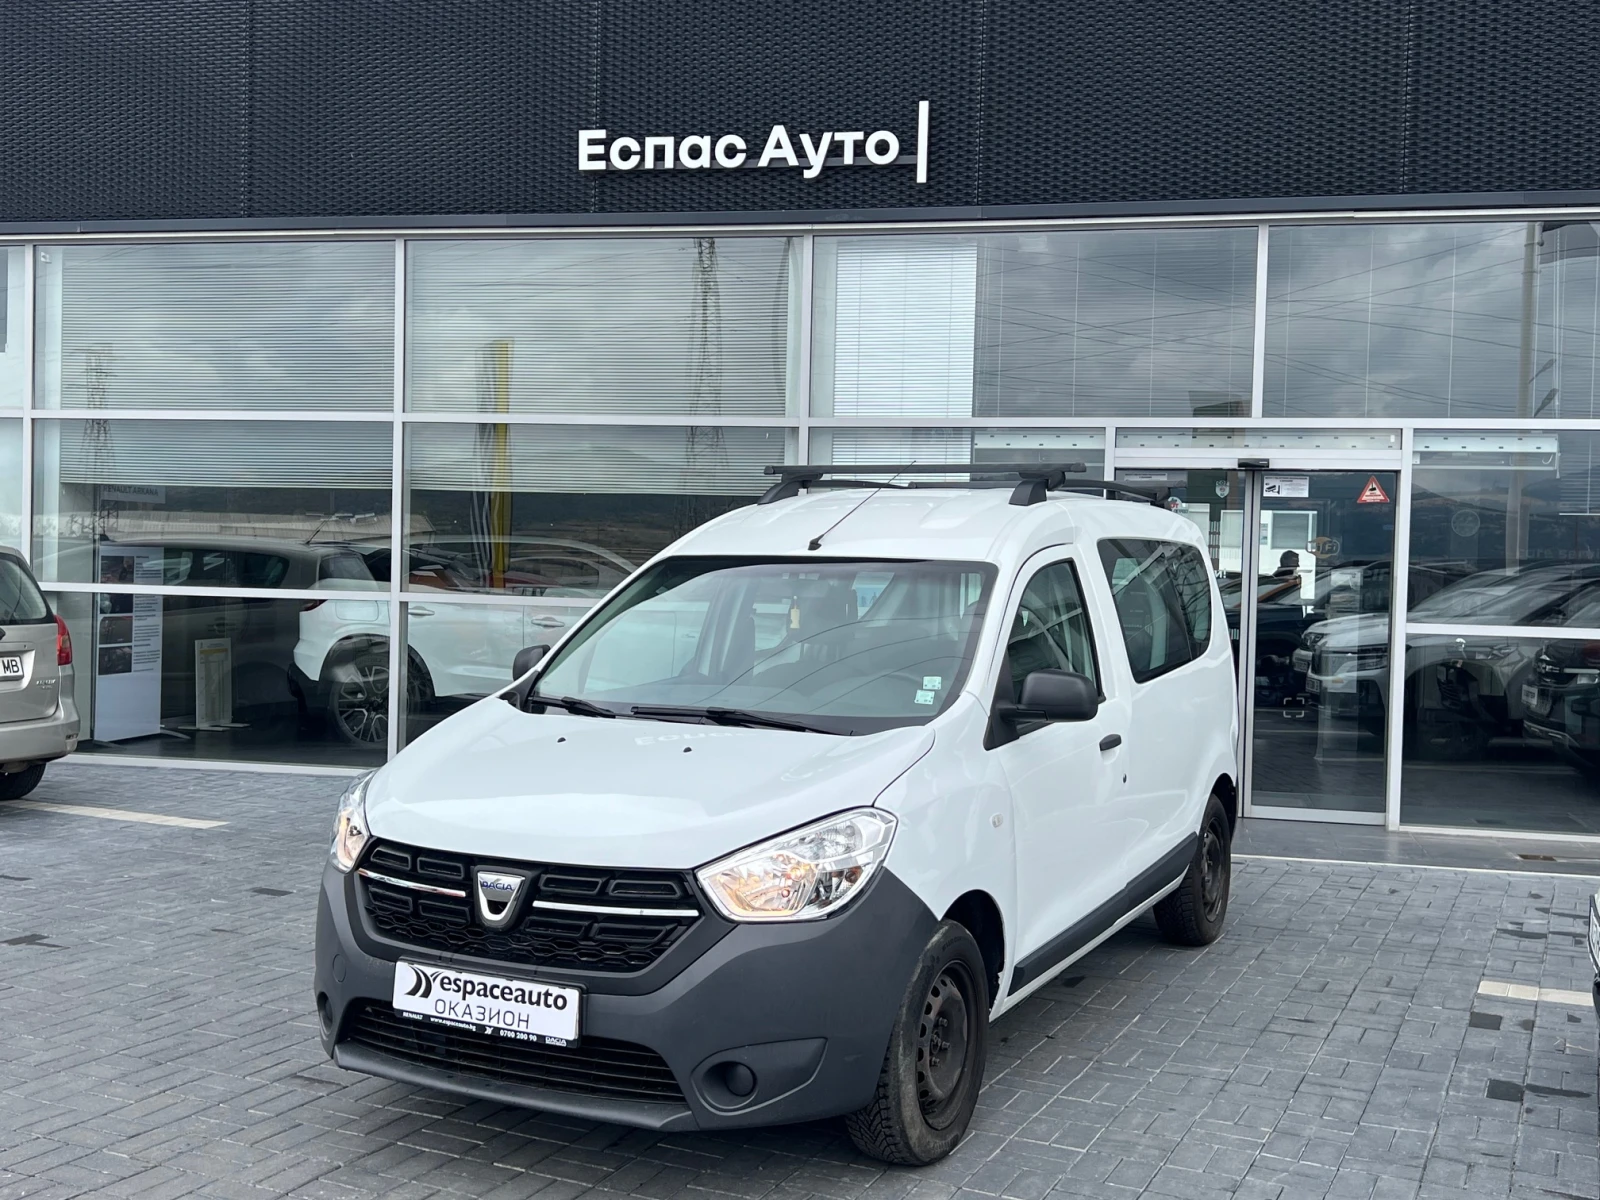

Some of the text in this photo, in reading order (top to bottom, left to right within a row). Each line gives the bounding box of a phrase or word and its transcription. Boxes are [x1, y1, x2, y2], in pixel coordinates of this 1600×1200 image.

[578, 124, 900, 179] Еспас Ауто
[103, 485, 159, 496] RENAULT ARKANA
[2, 659, 20, 674] MB
[481, 881, 513, 891] DACIA
[440, 975, 568, 1011] espaceauto
[402, 1011, 423, 1020] RENAULT
[430, 1016, 477, 1031] www.espaceauto.bg
[499, 1029, 515, 1039] 0700
[516, 1031, 529, 1040] 200
[529, 1033, 537, 1042] 90
[434, 998, 530, 1030] ОКАЗИОН
